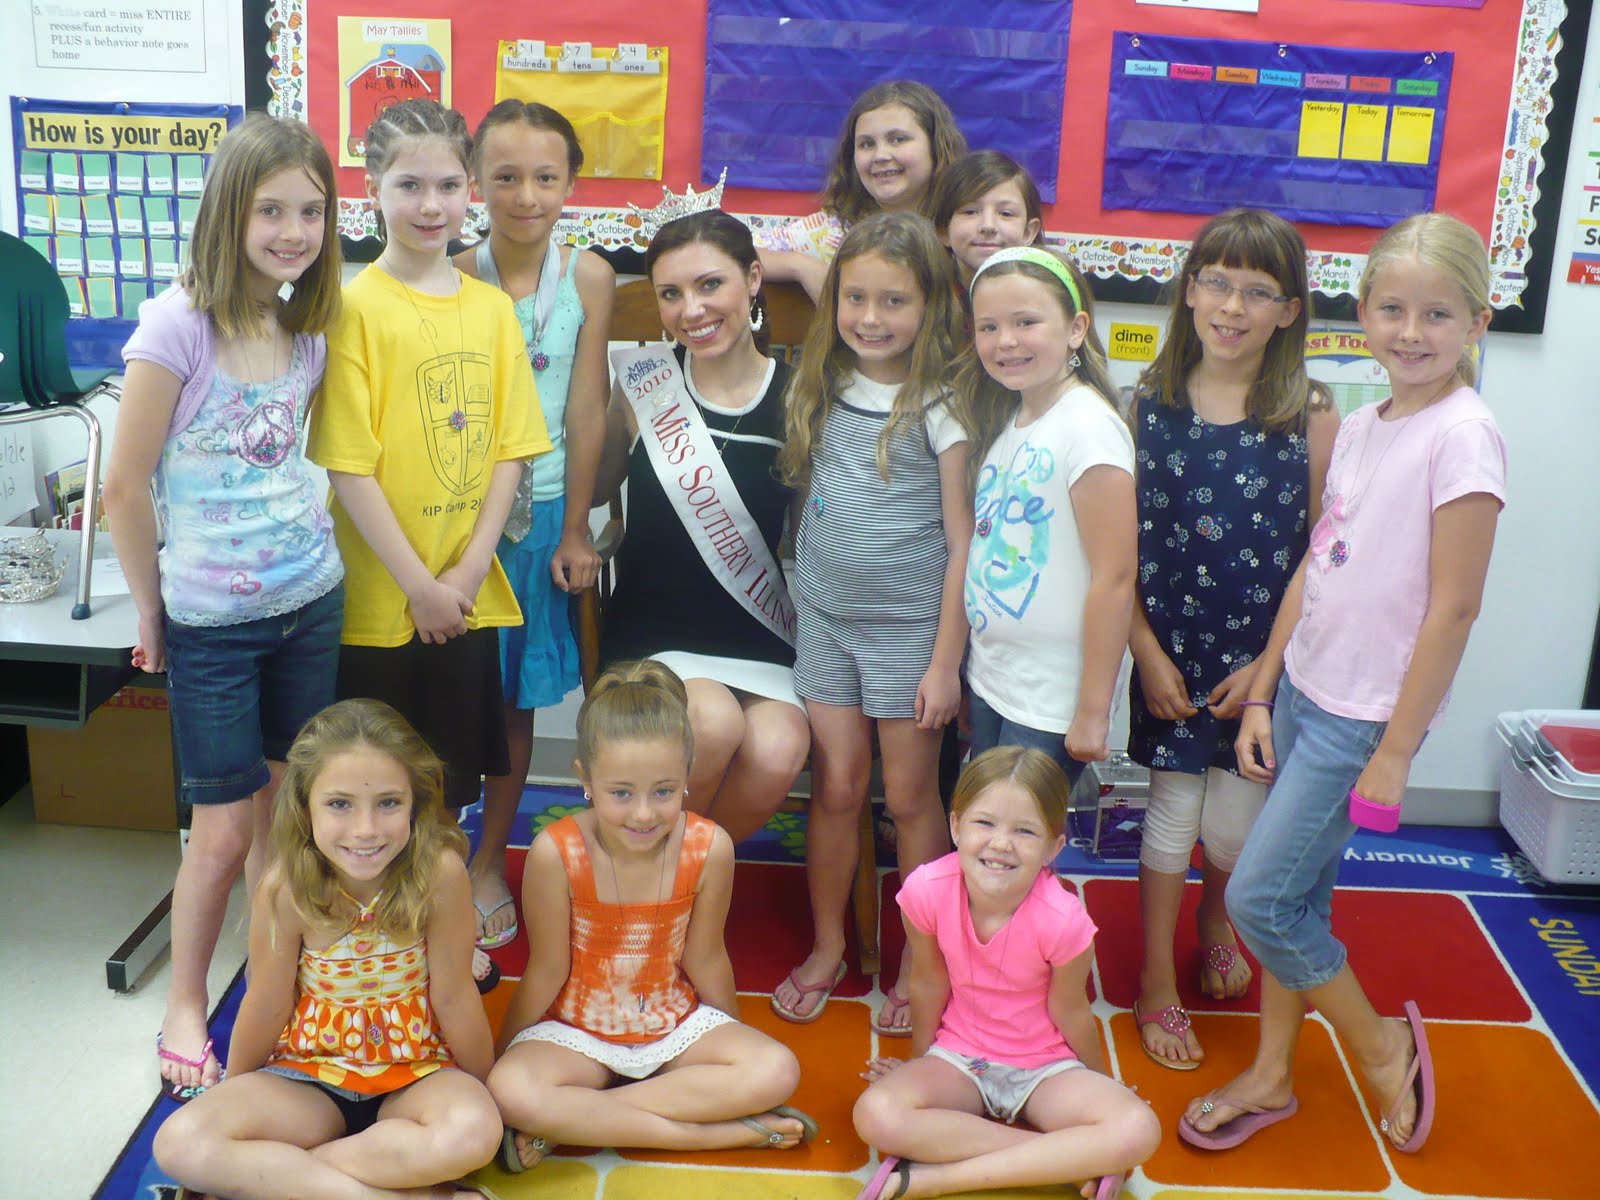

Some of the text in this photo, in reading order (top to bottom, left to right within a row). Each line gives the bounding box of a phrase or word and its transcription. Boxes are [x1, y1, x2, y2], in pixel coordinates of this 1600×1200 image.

[84, 9, 107, 18] card
[119, 10, 144, 19] miss
[147, 9, 191, 21] ENTIRE
[50, 22, 144, 35] recess/fun activity
[367, 25, 422, 36] May Tallies
[51, 34, 82, 46] PLUS
[94, 37, 139, 48] behavior
[142, 40, 164, 48] note
[167, 41, 189, 50] goes
[52, 50, 80, 60] home
[281, 32, 291, 74] November
[575, 46, 581, 55] 7
[630, 46, 637, 56] 4
[507, 55, 547, 69] hundreds
[573, 60, 592, 70] tens
[1134, 63, 1159, 75] Sunday
[1177, 67, 1206, 78] Monday
[1224, 70, 1249, 81] Tuesday
[1262, 72, 1300, 86] Wednesday
[1311, 76, 1341, 87] Thursday
[1402, 82, 1432, 93] Saturday
[1306, 102, 1341, 114] Yesterday
[1358, 106, 1379, 117] Today
[1396, 107, 1432, 118] Tomorrow
[29, 117, 223, 150] How is your day?
[1519, 114, 1532, 144] August
[1512, 151, 1527, 196] September
[597, 223, 633, 235] October
[1505, 207, 1519, 243] October
[1082, 250, 1118, 262] October
[1130, 254, 1171, 266] November
[1322, 268, 1349, 279] March
[1115, 328, 1154, 344] dime
[1116, 345, 1151, 356] (front)
[634, 368, 673, 400] 2010
[422, 505, 442, 517] KIP
[678, 465, 756, 579] SOUTHERN
[1344, 847, 1474, 869] January
